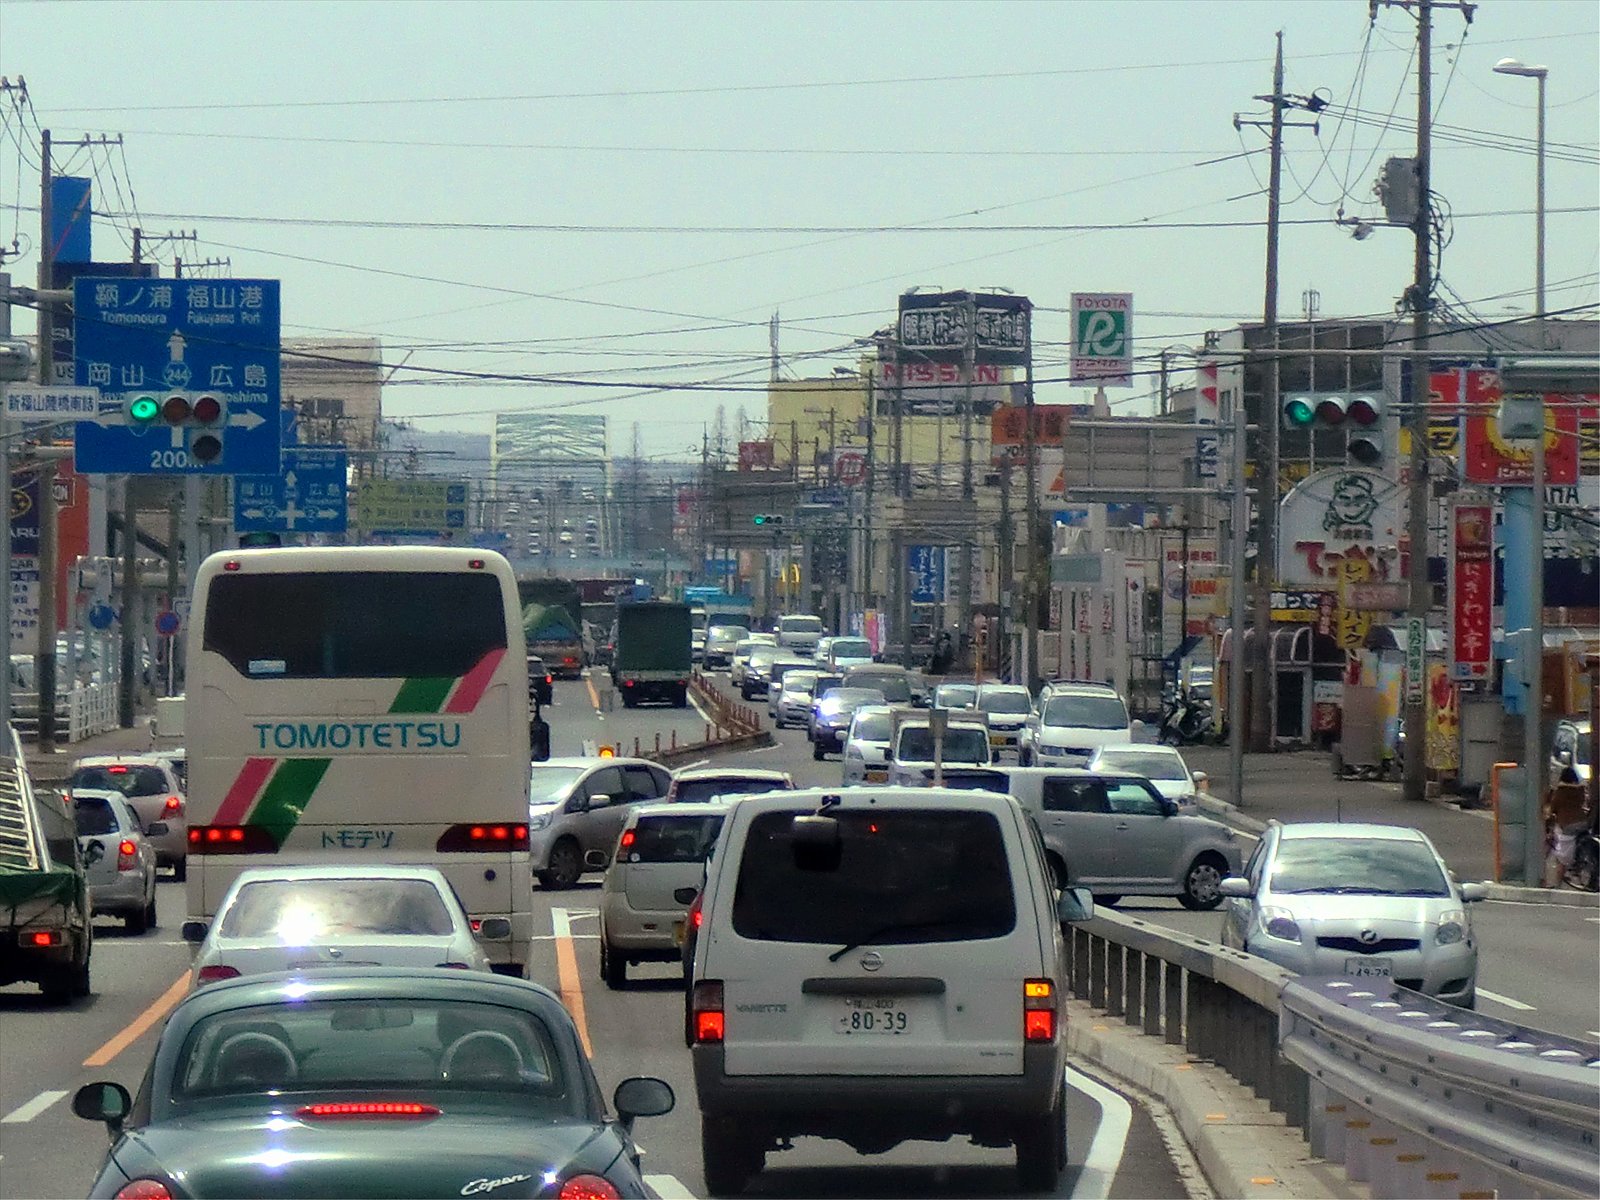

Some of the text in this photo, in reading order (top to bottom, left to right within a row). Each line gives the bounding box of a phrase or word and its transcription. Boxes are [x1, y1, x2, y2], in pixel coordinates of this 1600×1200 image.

[95, 284, 262, 308] 鞆ノ浦 福山港
[1077, 299, 1127, 308] TOYOTA
[102, 311, 260, 326] Tomonoura Fukuyama Port
[89, 363, 144, 386] 岡山
[167, 368, 188, 381] 244
[210, 364, 266, 387] 広島
[883, 364, 998, 383] NISSN
[151, 450, 203, 468] 200
[253, 723, 461, 748] TOMOTETSU
[321, 830, 394, 848] トモテツ
[851, 1012, 907, 1030] 80-39
[460, 1174, 532, 1196] Copen
